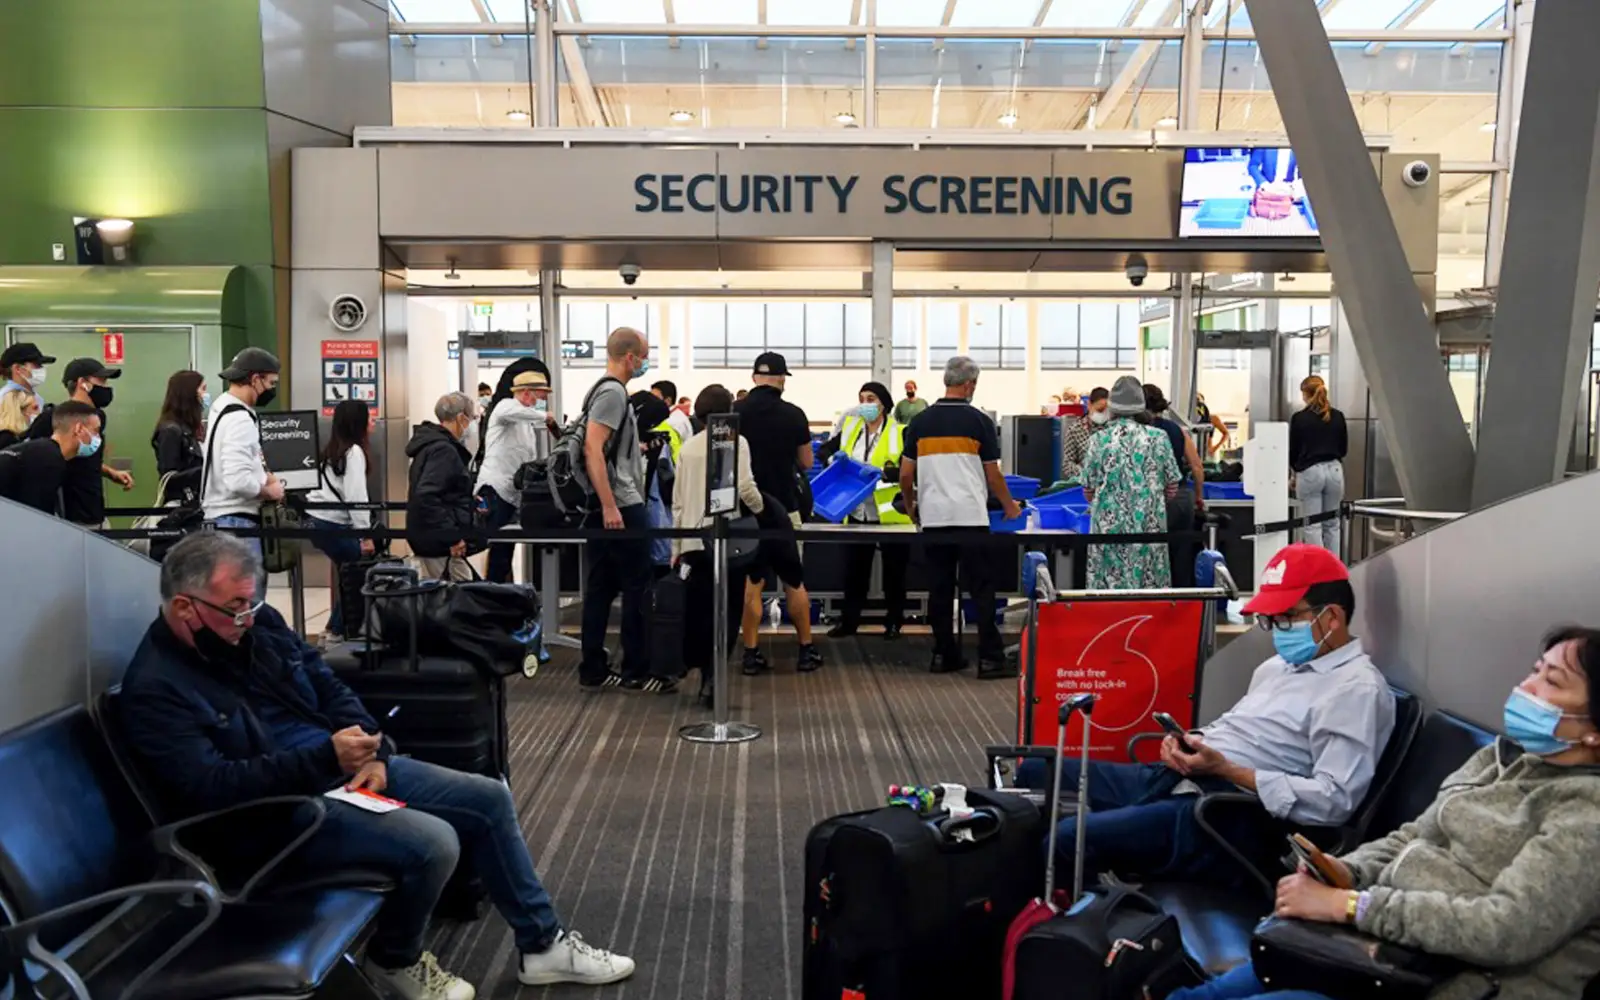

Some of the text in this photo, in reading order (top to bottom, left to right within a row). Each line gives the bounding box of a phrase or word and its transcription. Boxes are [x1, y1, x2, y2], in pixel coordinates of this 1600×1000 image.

[634, 173, 1133, 215] SECURITY SCREENING
[261, 418, 300, 429] Security
[261, 430, 310, 441] Screening
[1056, 668, 1107, 678] Break free
[1056, 680, 1126, 689] with no lock-in
[1055, 691, 1102, 701] conts
